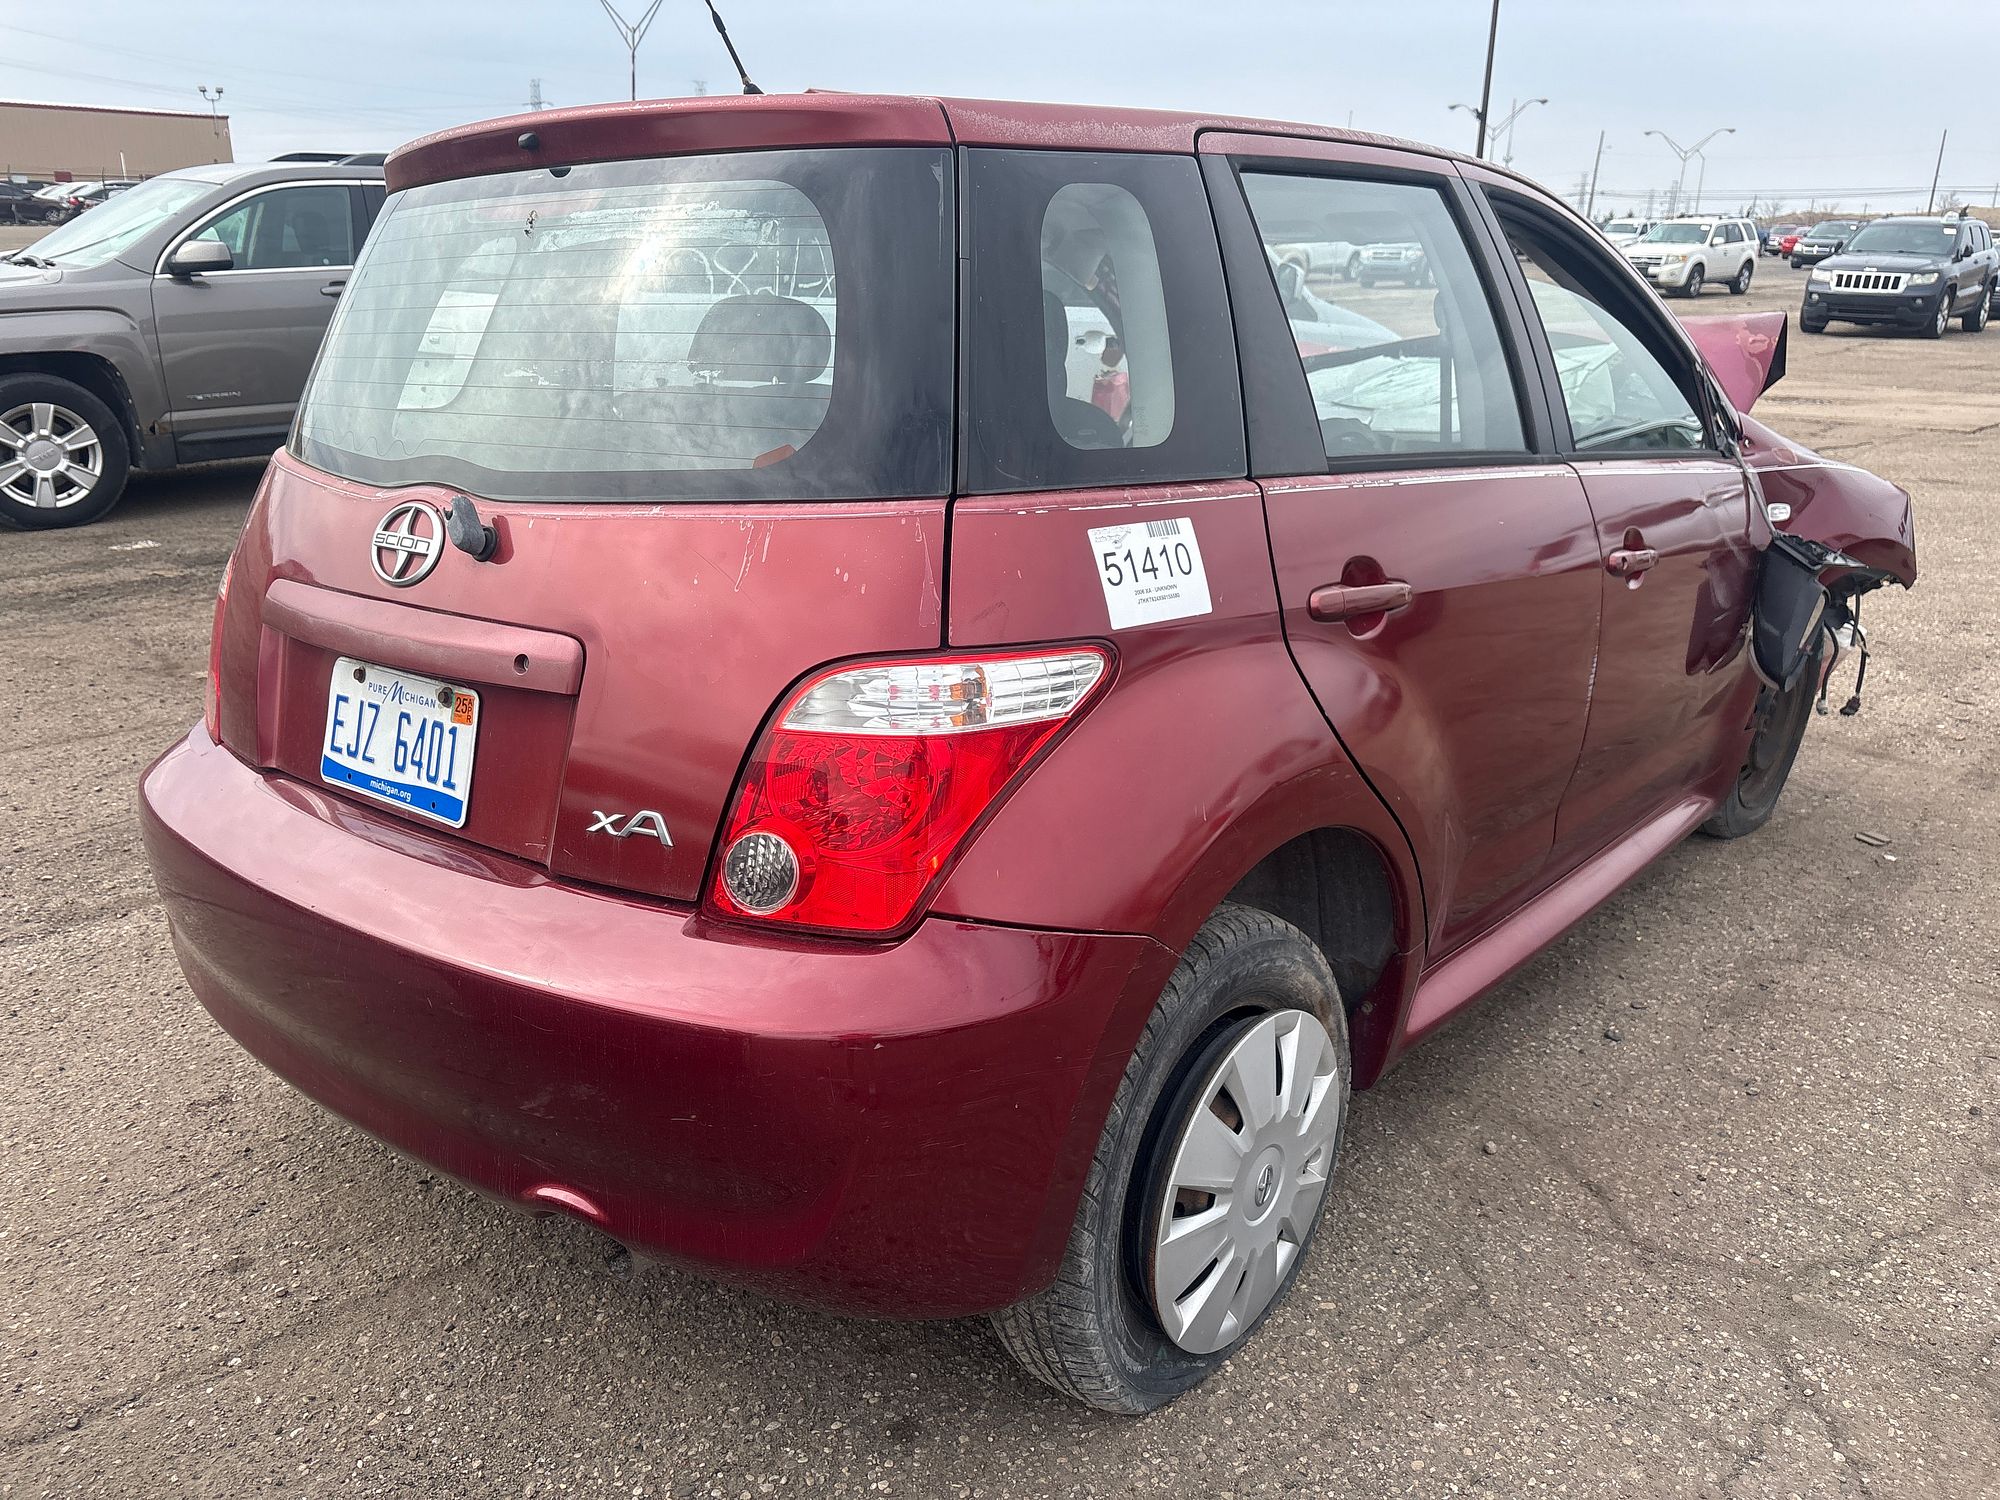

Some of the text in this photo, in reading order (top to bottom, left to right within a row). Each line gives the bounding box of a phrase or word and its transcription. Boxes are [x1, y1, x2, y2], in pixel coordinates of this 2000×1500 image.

[374, 532, 431, 552] SCION
[1103, 543, 1192, 586] 51410
[368, 682, 387, 695] PURE
[455, 697, 468, 714] 25
[330, 694, 460, 791] EJZ 6401
[369, 778, 412, 802] michigan.org
[585, 809, 674, 847] xA
